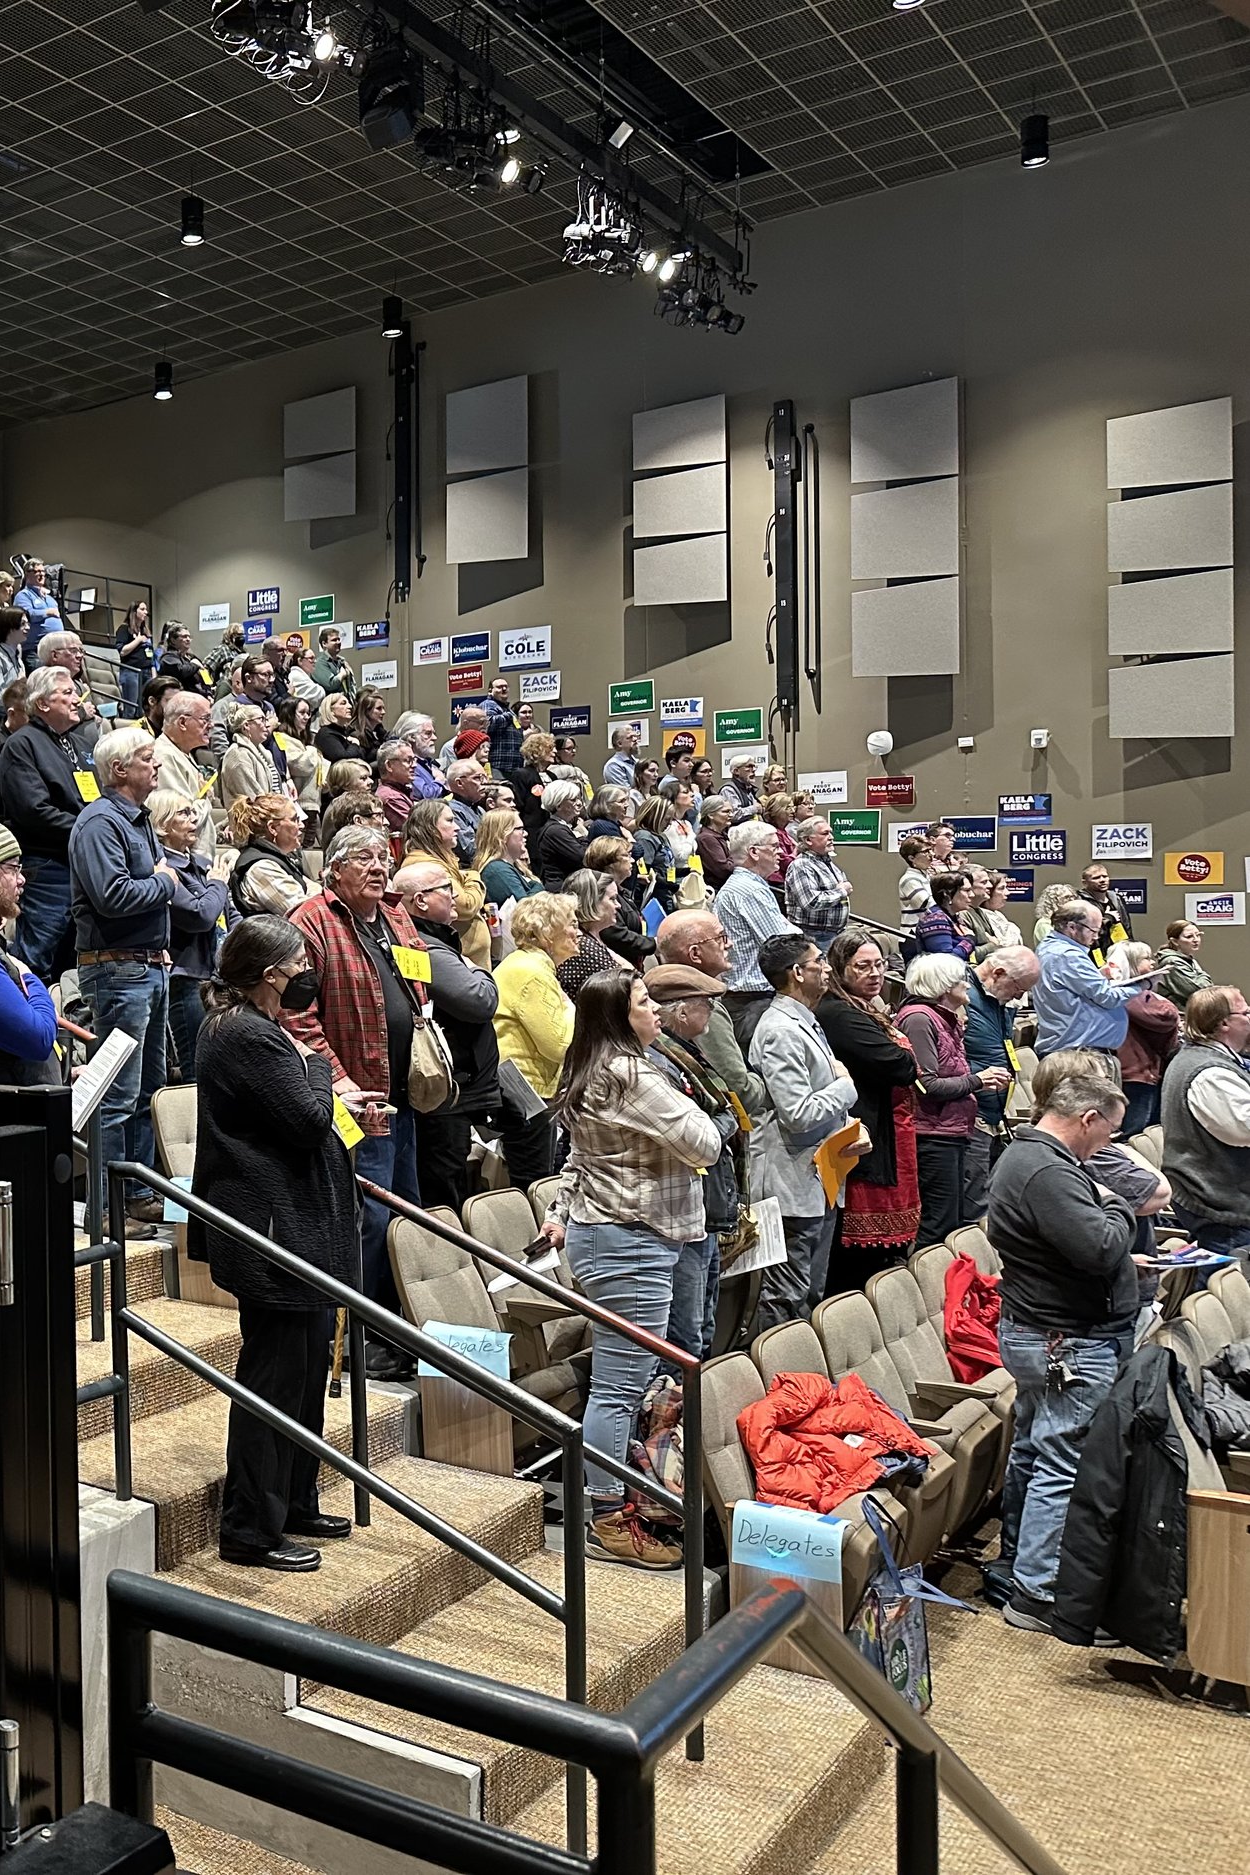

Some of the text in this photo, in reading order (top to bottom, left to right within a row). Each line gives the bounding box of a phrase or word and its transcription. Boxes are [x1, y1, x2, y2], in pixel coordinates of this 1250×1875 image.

[249, 590, 278, 606] Little
[249, 603, 278, 613] CONGRESS
[303, 603, 317, 612] Amy
[247, 626, 267, 635] CRAIG
[356, 623, 379, 632] KAELA
[359, 629, 377, 637] BERG
[420, 647, 441, 656] CRAIG
[504, 640, 545, 656] COLE
[365, 674, 394, 682] FLANAGAN
[522, 674, 557, 687] ZACK
[522, 685, 558, 694] FILIPOVICH
[614, 690, 632, 698] Amy
[620, 699, 647, 707] GOVERNOR
[662, 700, 689, 708] KAELA
[664, 706, 686, 714] BERG
[553, 719, 587, 728] FLANAGAN
[719, 718, 739, 726] Amy
[677, 735, 693, 743] Vote
[868, 783, 913, 792] Vote Betty!
[999, 795, 1035, 805] KAELA
[1003, 803, 1031, 811] BERG
[833, 818, 855, 826] Amy
[954, 830, 994, 839] obuchar
[1096, 827, 1148, 840] ZACK
[1012, 834, 1064, 852] Little
[1184, 858, 1206, 868] Vote
[1179, 863, 1209, 875] Betty!
[1197, 902, 1233, 913] CRAIG
[433, 1335, 505, 1354] legates
[737, 1518, 836, 1558] Delegates
